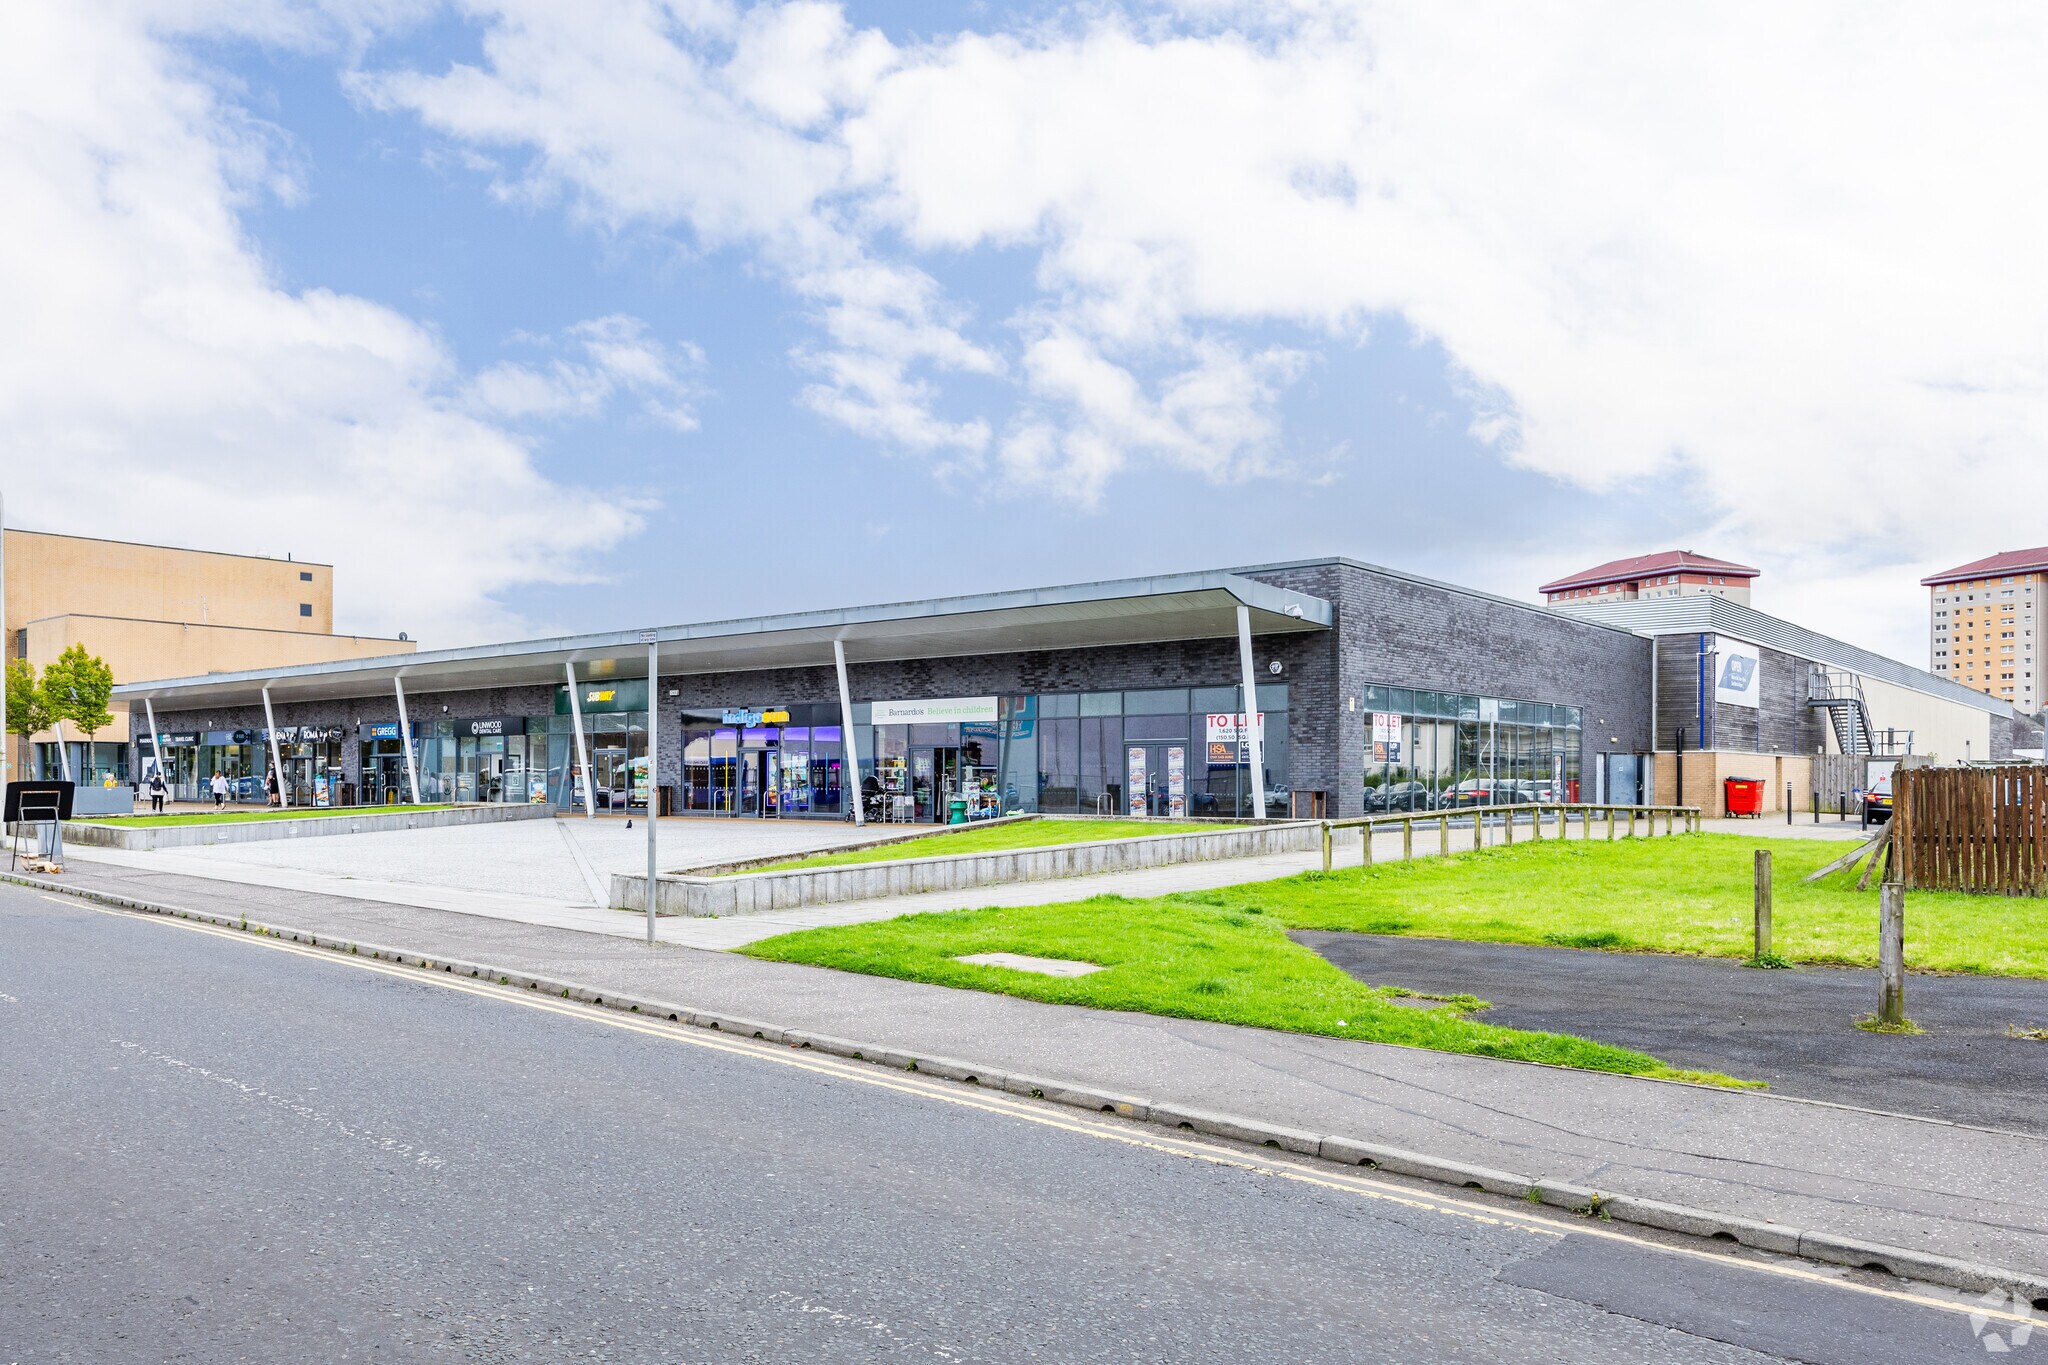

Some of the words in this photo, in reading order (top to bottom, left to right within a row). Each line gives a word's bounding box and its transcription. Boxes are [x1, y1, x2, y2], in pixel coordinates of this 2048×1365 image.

[587, 690, 616, 702] SUBWAY
[888, 708, 925, 717] Barnardo's
[927, 707, 951, 715] Believe
[954, 706, 962, 714] in
[962, 705, 994, 714] children
[479, 721, 502, 729] LINWOOD
[1208, 715, 1228, 727] TO
[1234, 714, 1263, 726] LT
[1374, 714, 1384, 726] TO
[1387, 716, 1400, 727] LET
[377, 726, 397, 736] GREGG
[1210, 744, 1226, 754] HSA
